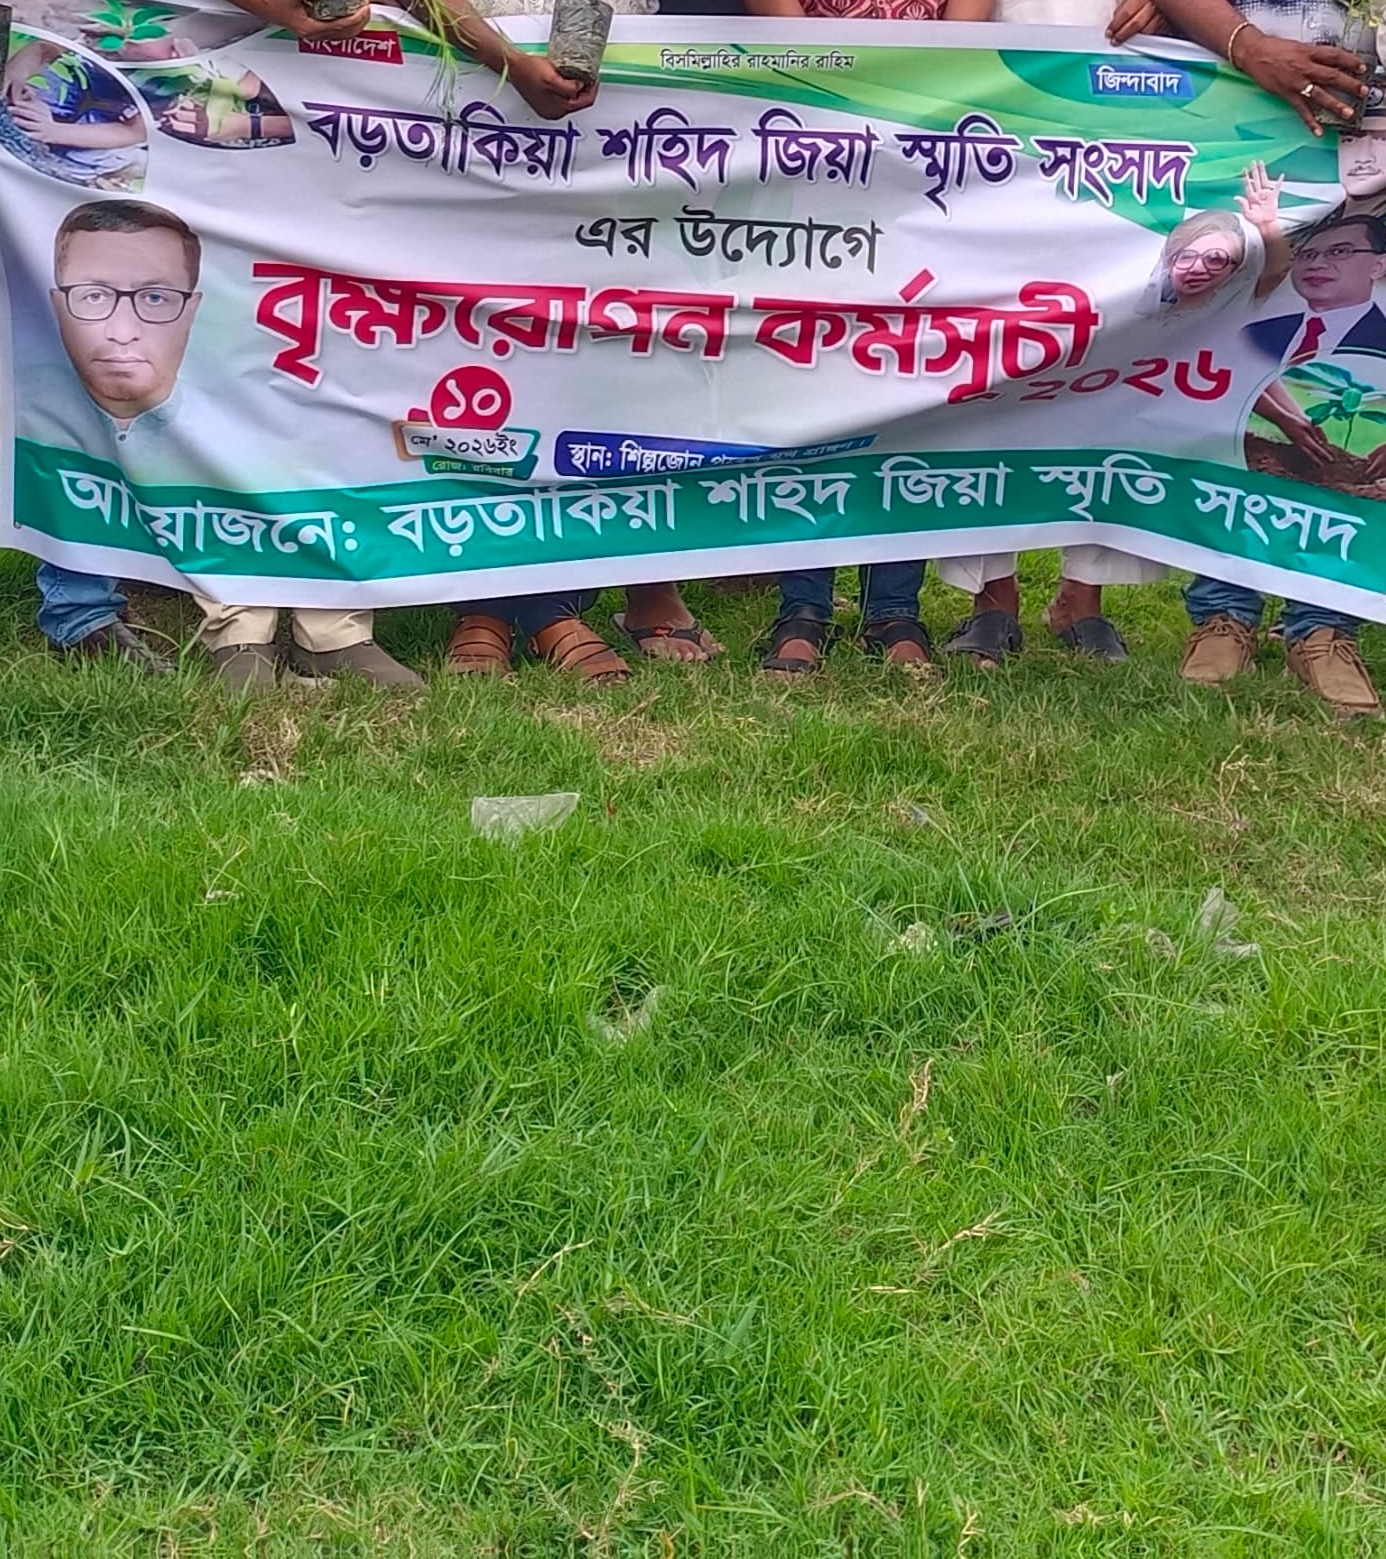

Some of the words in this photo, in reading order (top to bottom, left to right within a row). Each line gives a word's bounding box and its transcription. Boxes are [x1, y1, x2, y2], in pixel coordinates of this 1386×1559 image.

[661, 48, 742, 70] বিসমিল্লাহির
[747, 49, 810, 70] রাহমানির
[815, 50, 855, 70] রাহিম
[1097, 65, 1182, 95] জিন্দাবাদ
[301, 100, 580, 182] বড়তাকিয়া
[595, 107, 736, 190] শহিদ
[753, 107, 881, 186] জিয়া
[895, 114, 1020, 215] স্মৃতি
[1032, 140, 1196, 204] সংসদ
[575, 216, 658, 260] এর
[681, 205, 884, 274] উদ্যোগে
[252, 262, 736, 385] বৃক্ষরোপন
[752, 269, 1101, 404] কর্মসূচী
[1019, 350, 1233, 402] ২০২৬
[442, 376, 503, 421] ১০
[444, 432, 518, 457] ২০২৬ইং
[619, 440, 705, 473] শিল্পজোন
[380, 478, 683, 557] বড়তাকিয়া
[699, 466, 859, 525] শহিদ
[873, 455, 1015, 511] জিয়া
[1030, 452, 1173, 523] স্মৃতি
[1192, 477, 1367, 563] সংসদ
